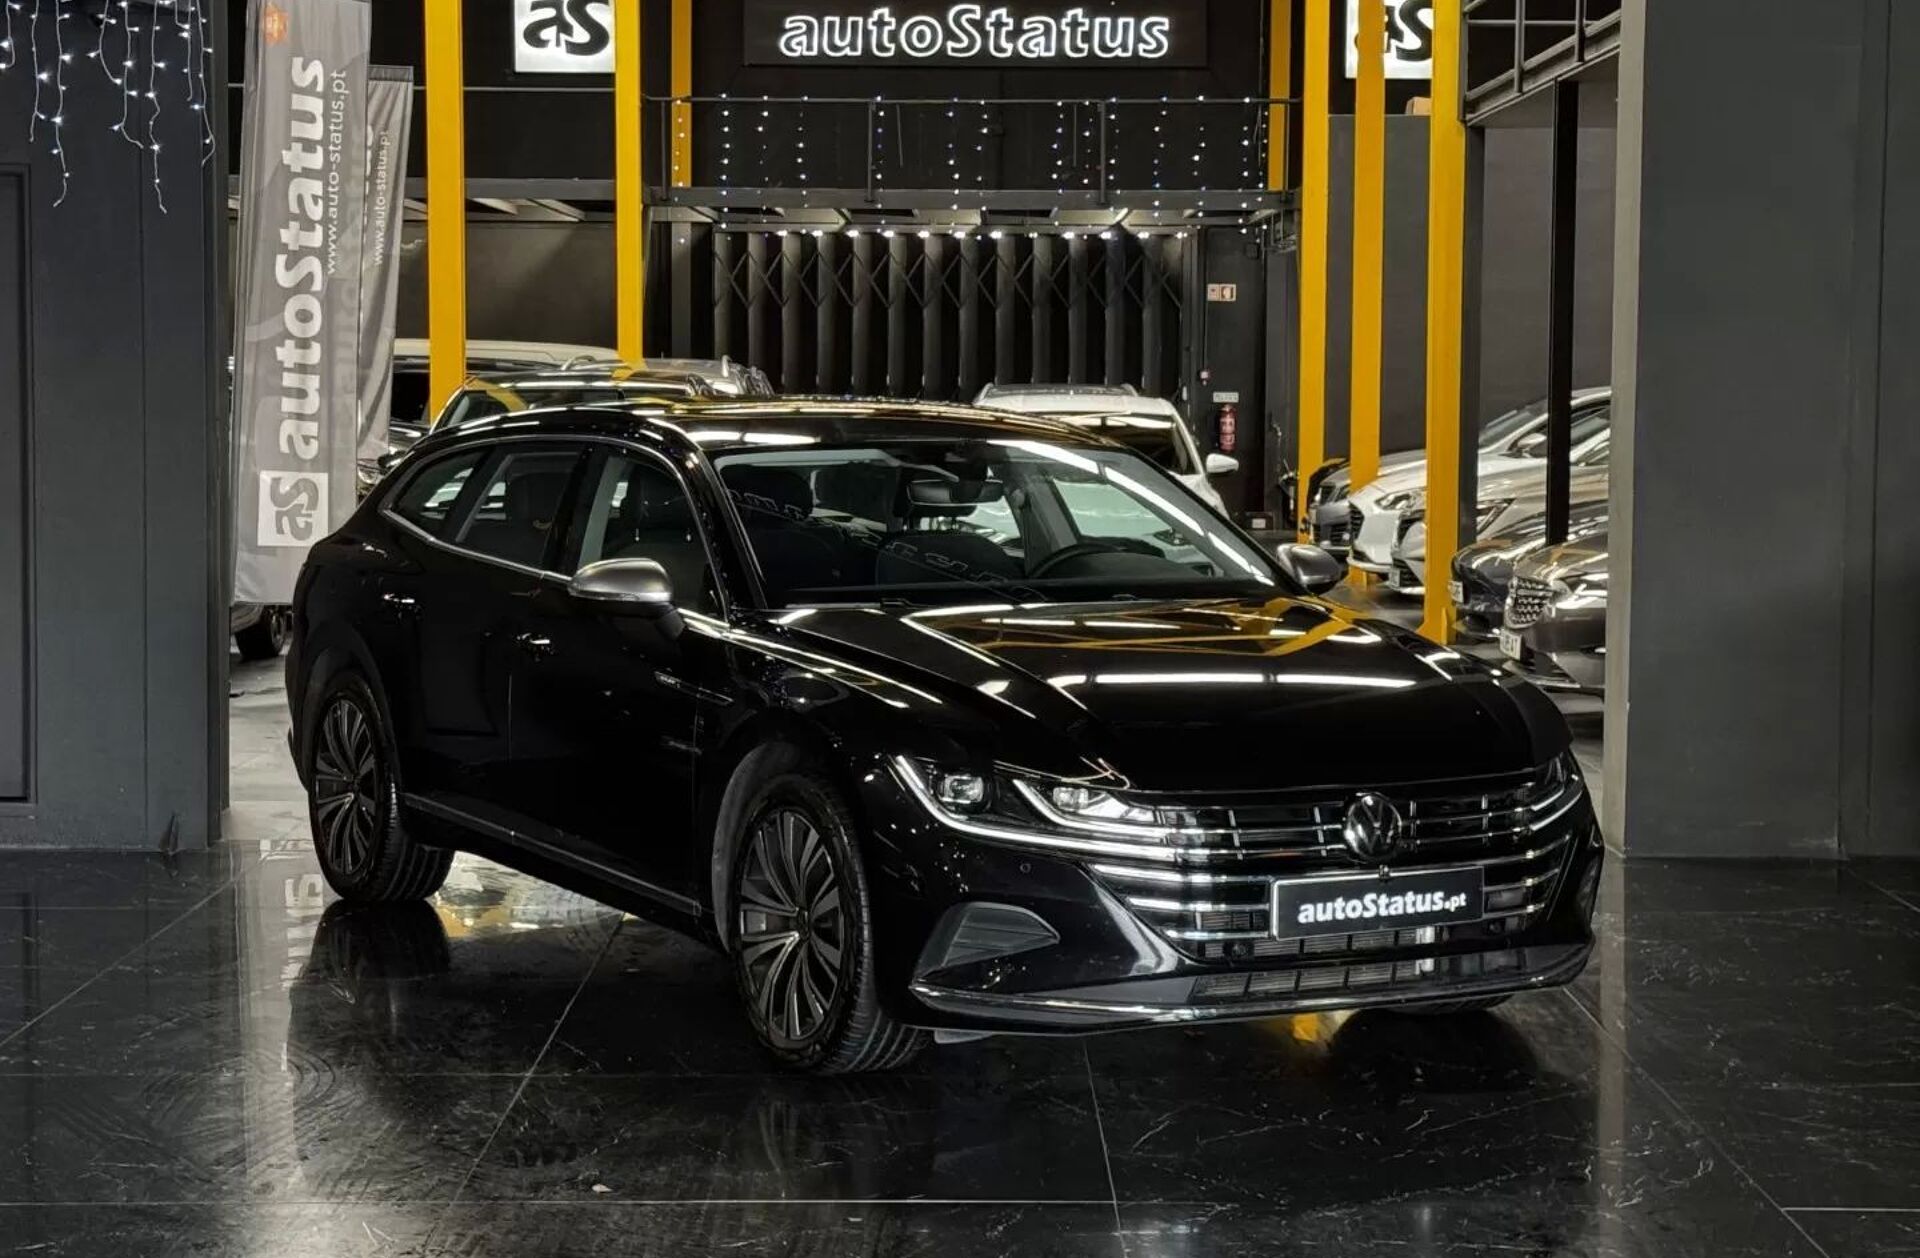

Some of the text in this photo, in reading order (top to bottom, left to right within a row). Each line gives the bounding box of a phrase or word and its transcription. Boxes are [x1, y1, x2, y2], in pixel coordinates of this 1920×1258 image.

[778, 3, 1170, 58] autoStatus
[326, 69, 347, 275] www.auto-status.pt
[372, 130, 389, 266] www.auto-status.pt
[275, 56, 324, 460] autoStatus
[1297, 891, 1467, 923] autoStatus.pt
